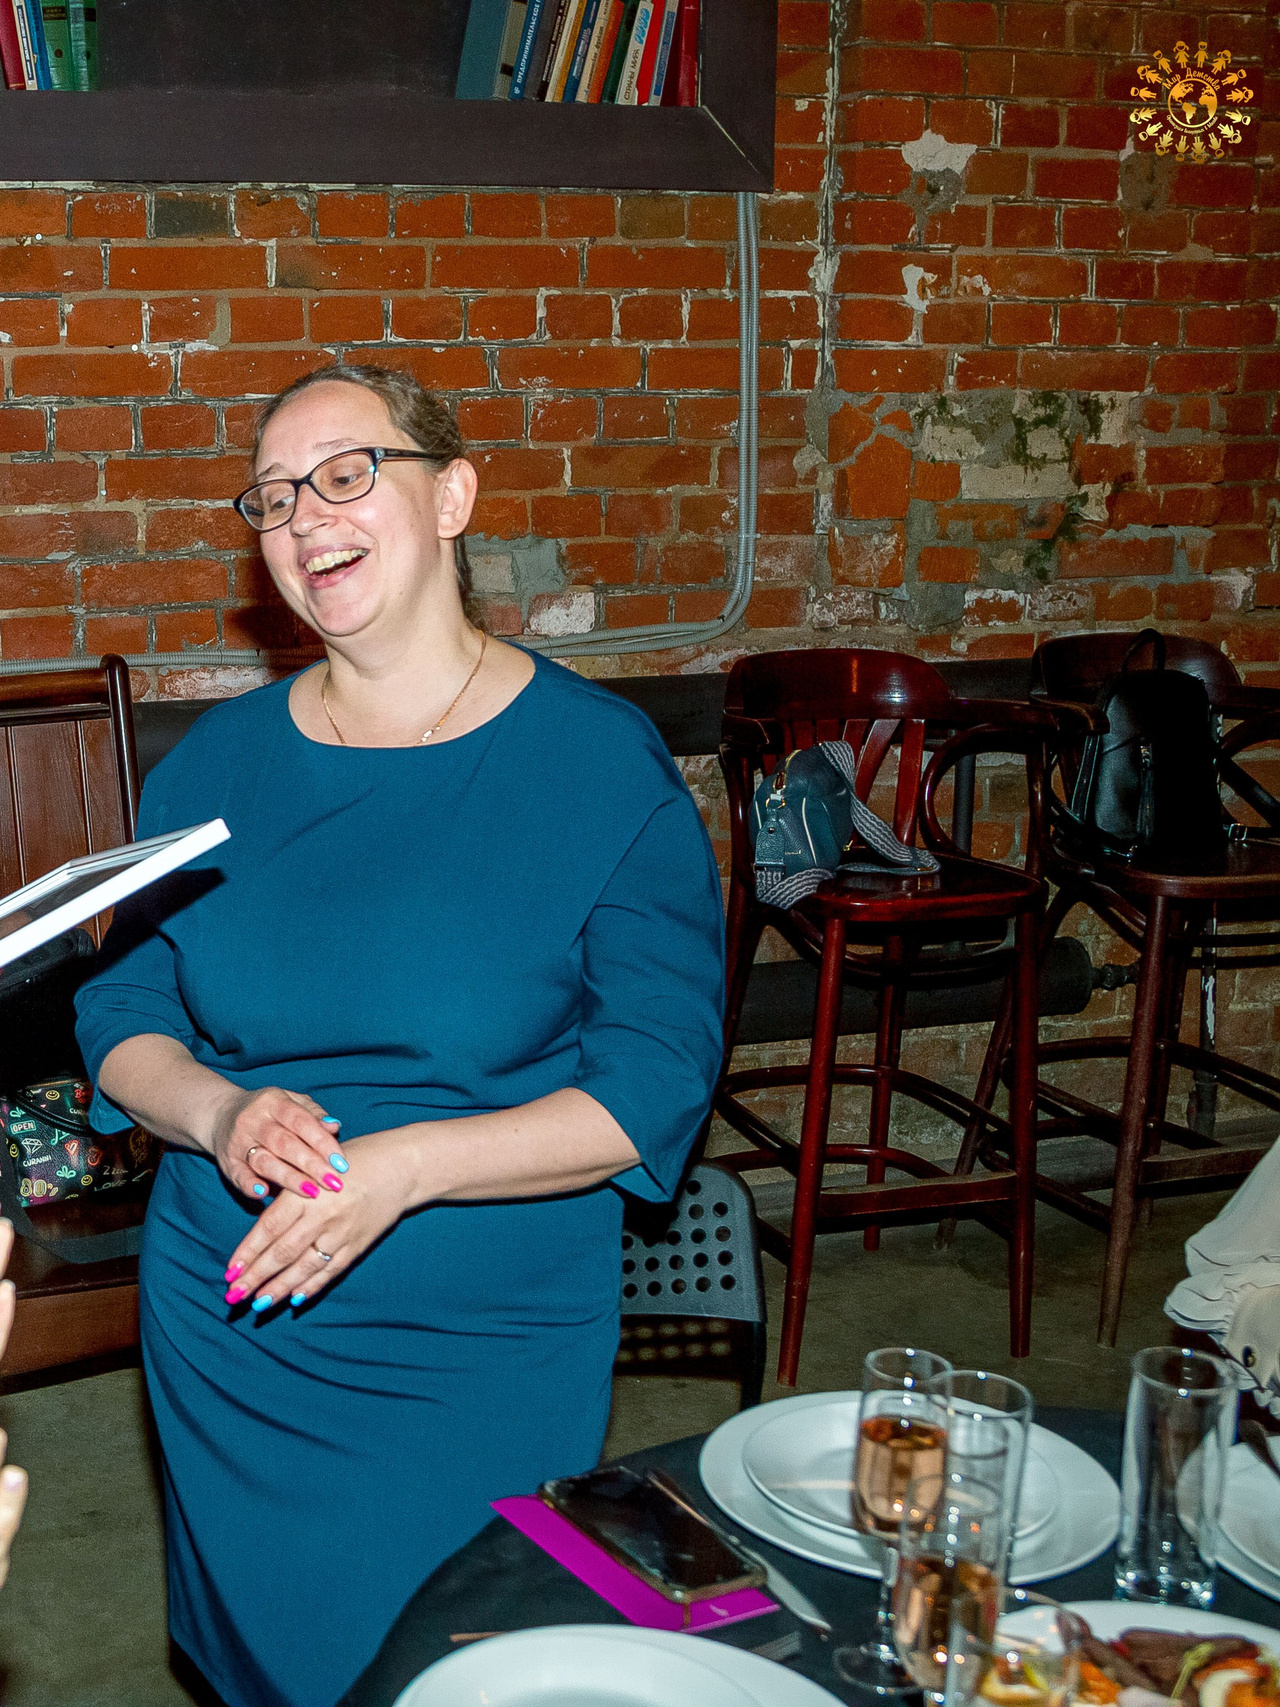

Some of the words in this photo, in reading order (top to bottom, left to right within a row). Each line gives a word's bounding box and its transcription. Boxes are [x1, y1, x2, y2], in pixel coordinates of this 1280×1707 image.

[624, 71, 636, 101] СТРАНЫ
[631, 48, 640, 70] МИРА
[11, 1121, 35, 1132] OPEN
[94, 1180, 127, 1192] LOVE
